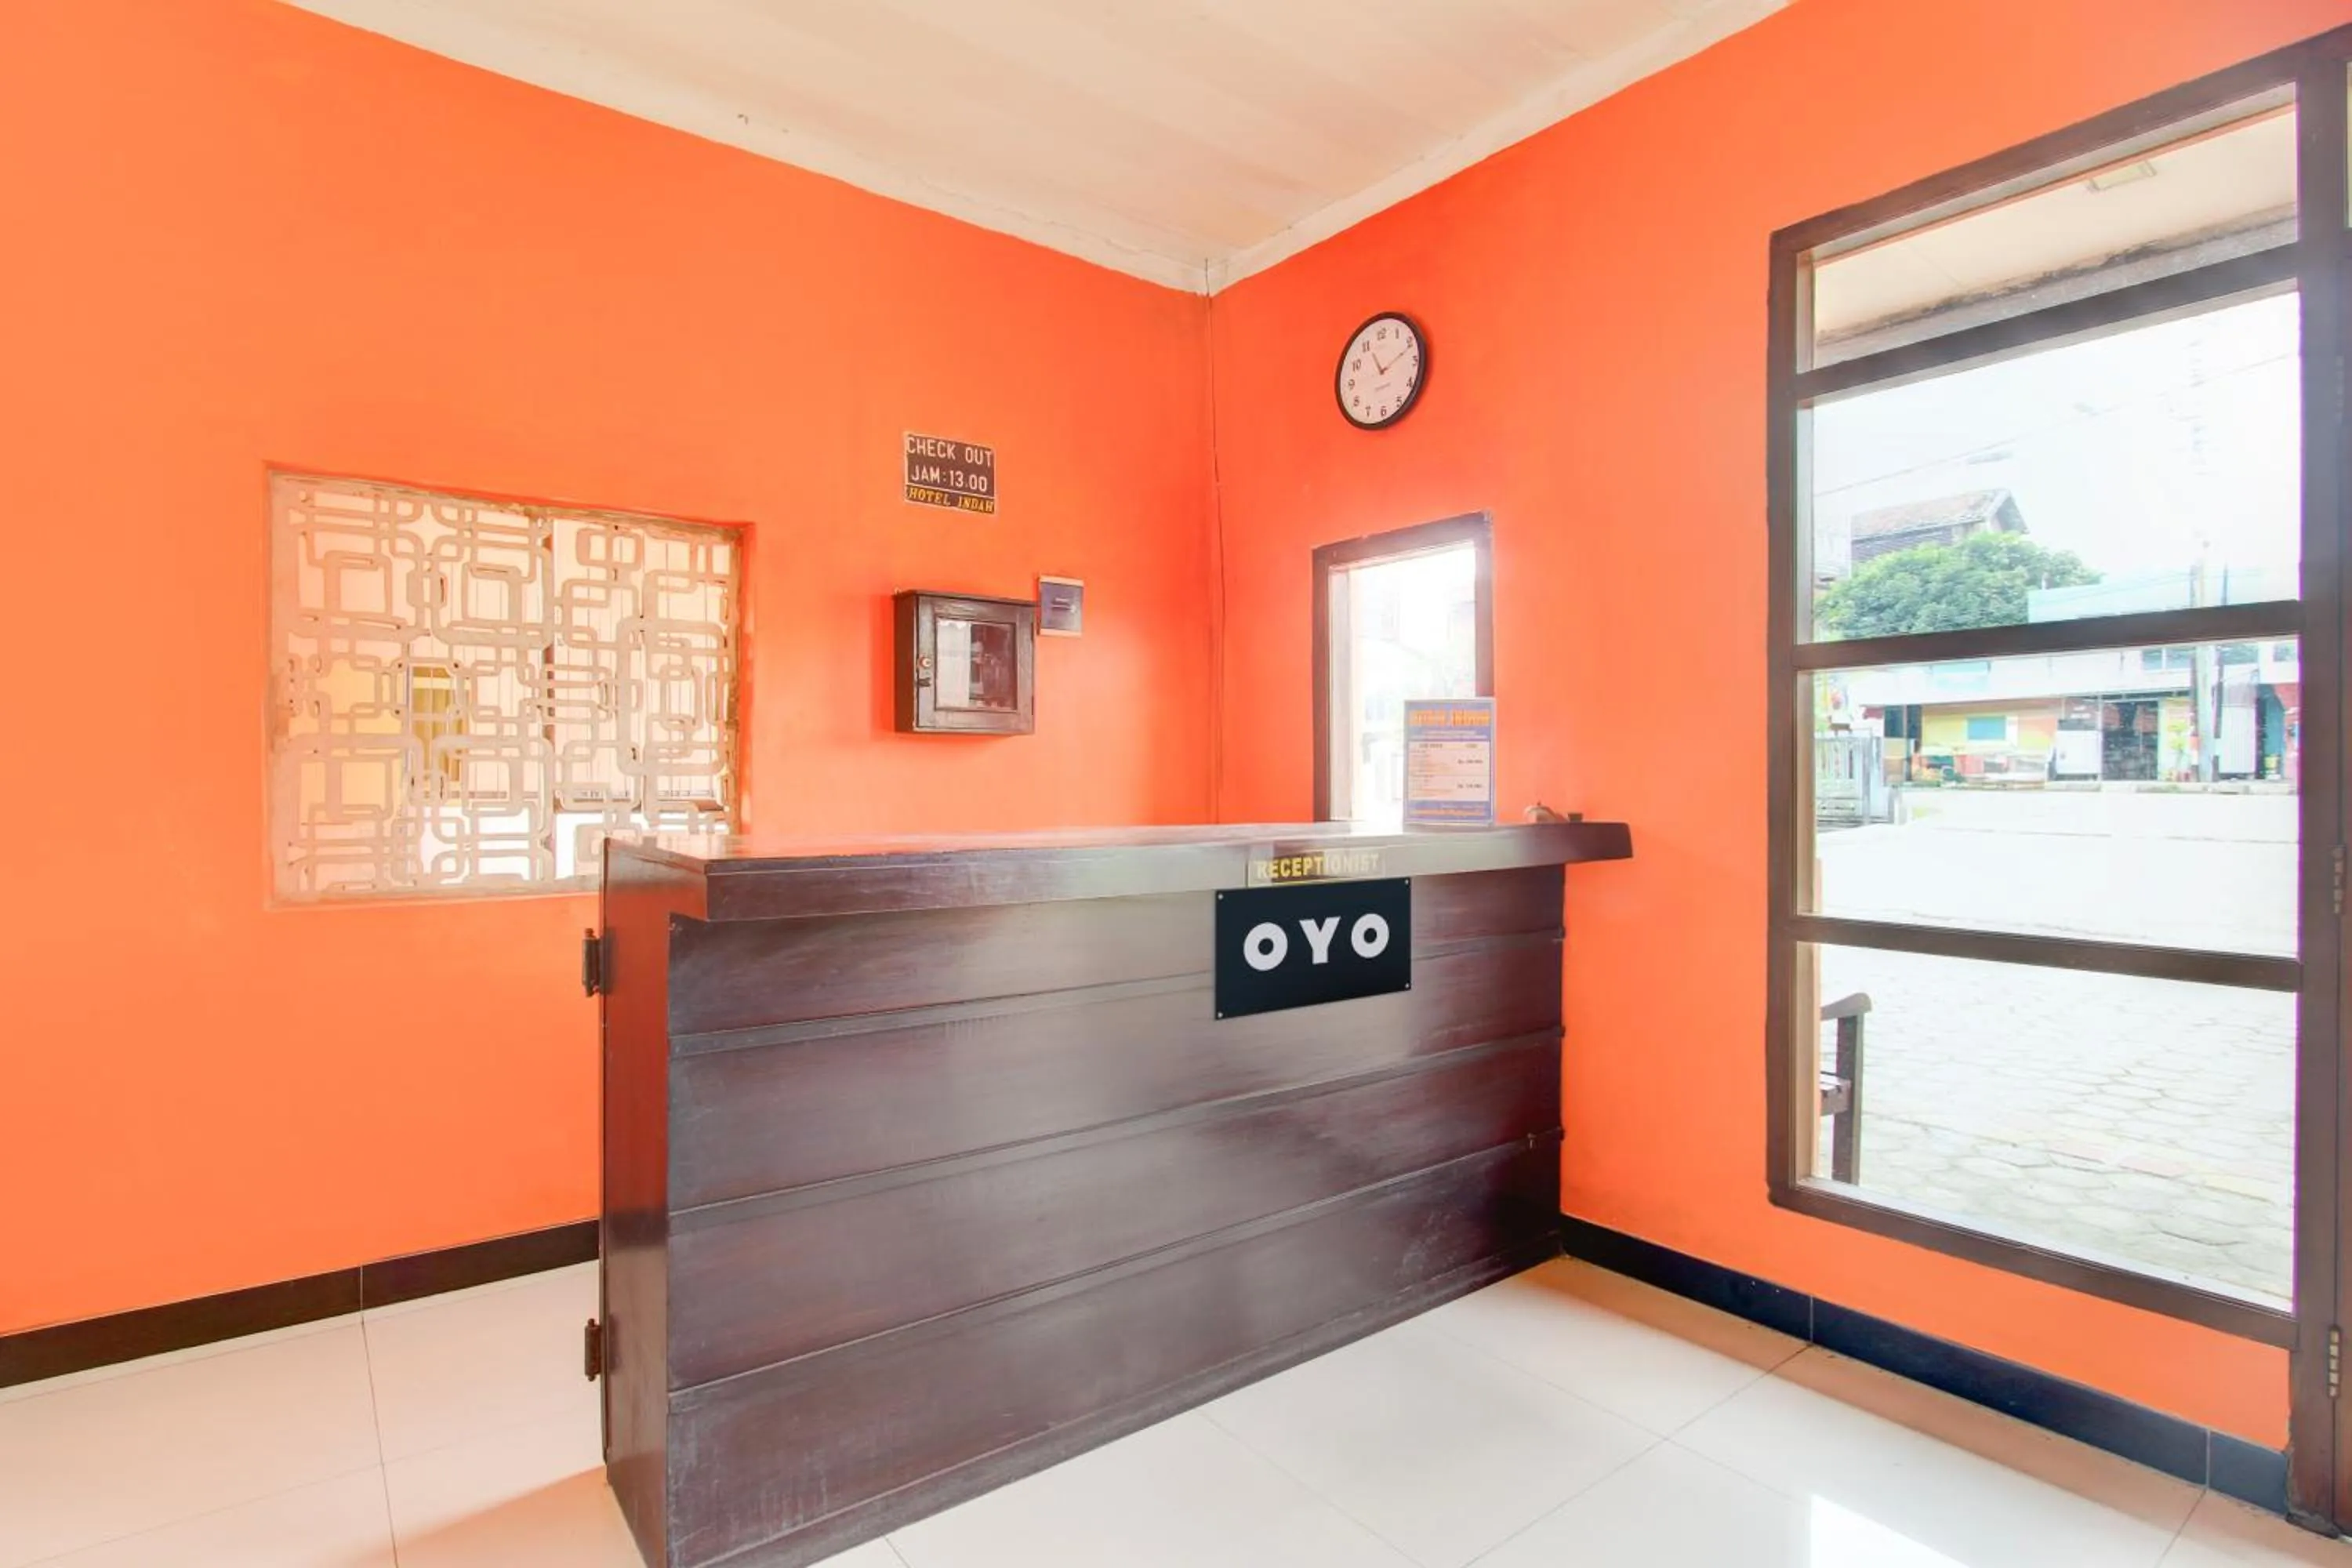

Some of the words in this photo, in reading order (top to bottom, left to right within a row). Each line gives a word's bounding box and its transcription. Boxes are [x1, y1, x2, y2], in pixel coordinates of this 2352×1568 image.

[1377, 328, 1387, 340] 12
[1362, 340, 1370, 353] 11
[1406, 336, 1413, 348] 2
[1352, 358, 1362, 372] 10
[1412, 355, 1418, 366] 3
[1348, 379, 1356, 390] 9
[1406, 376, 1413, 387] 4
[1396, 396, 1403, 408] 5
[1365, 405, 1371, 417] 7
[1380, 406, 1387, 416] 6
[907, 436, 956, 460] CHECK
[965, 447, 992, 467] OUT
[909, 486, 951, 506] HOTEL
[958, 495, 993, 512] INDAH
[1258, 854, 1379, 879] RECEPTIONIST
[1243, 913, 1390, 971] OYO
